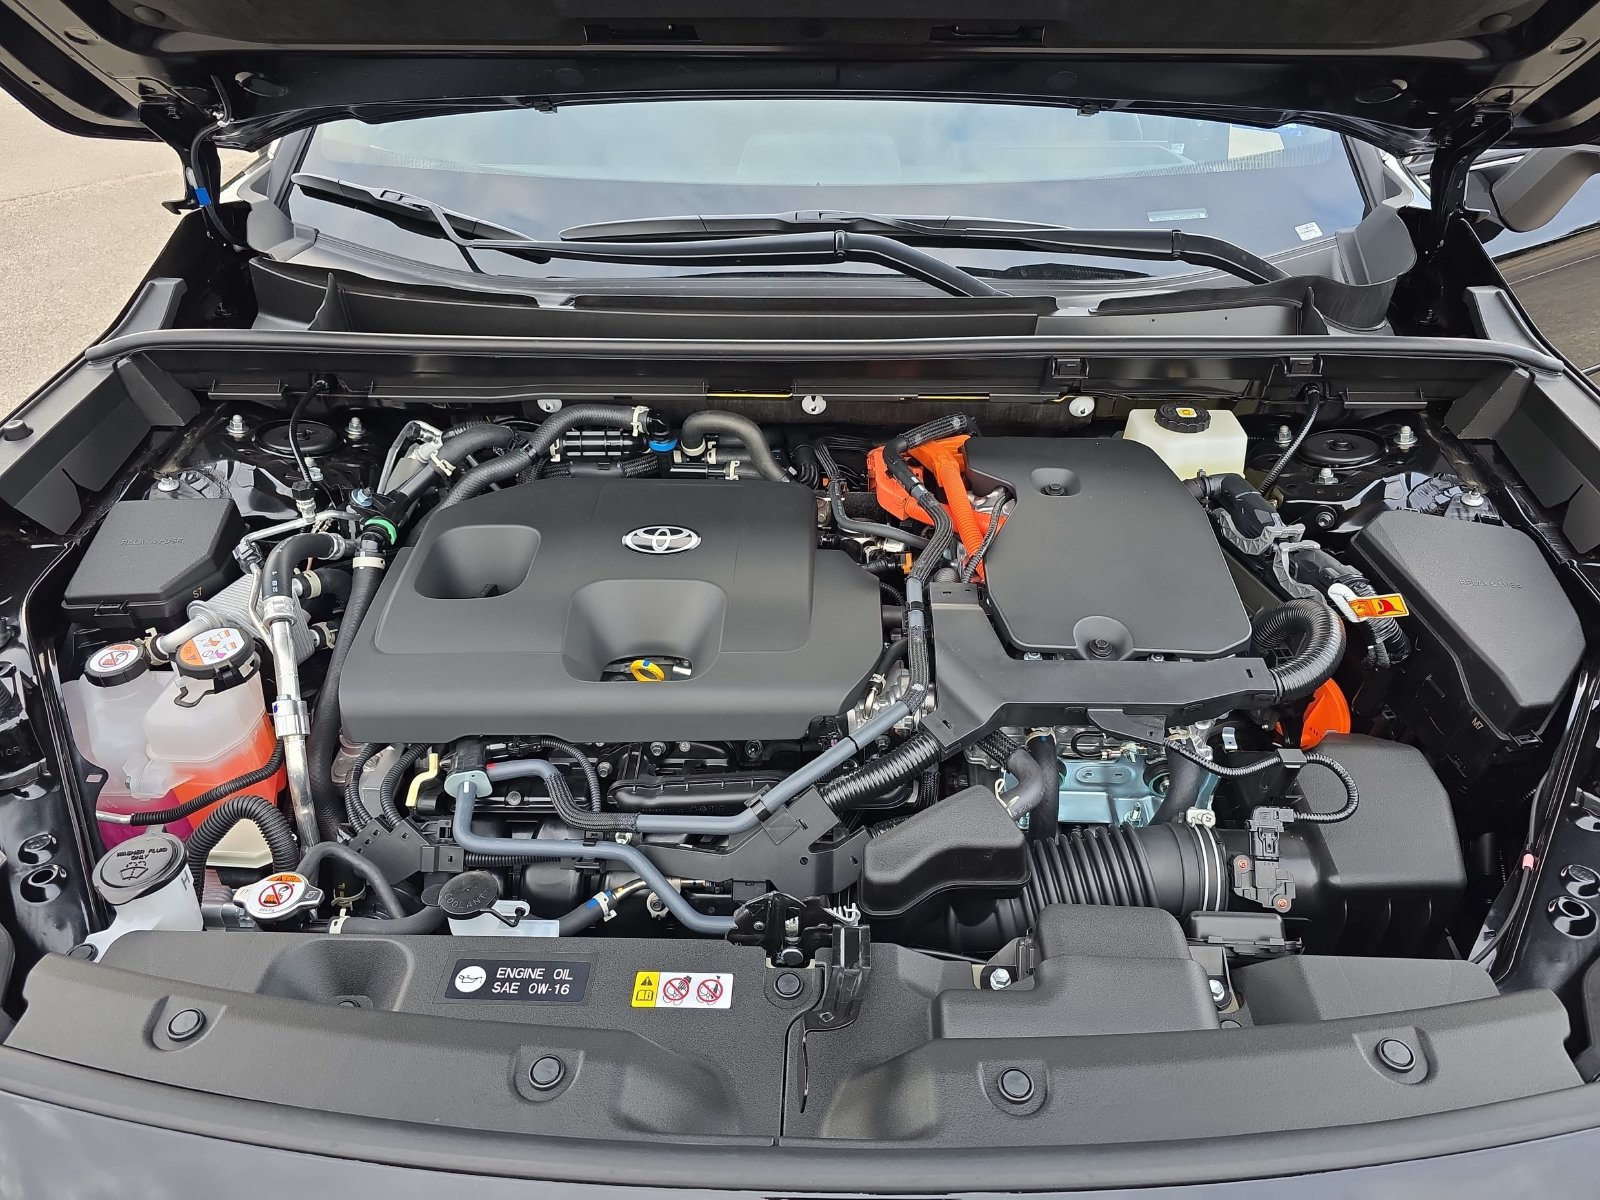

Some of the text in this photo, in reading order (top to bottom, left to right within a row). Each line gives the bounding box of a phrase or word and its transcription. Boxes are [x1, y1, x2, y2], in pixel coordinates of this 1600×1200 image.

[1471, 716, 1484, 730] M7
[116, 849, 145, 857] WASHER
[444, 892, 486, 909] COOLANT
[496, 967, 573, 981] ENGINE OIL
[491, 981, 570, 996] SAE 0W-16
